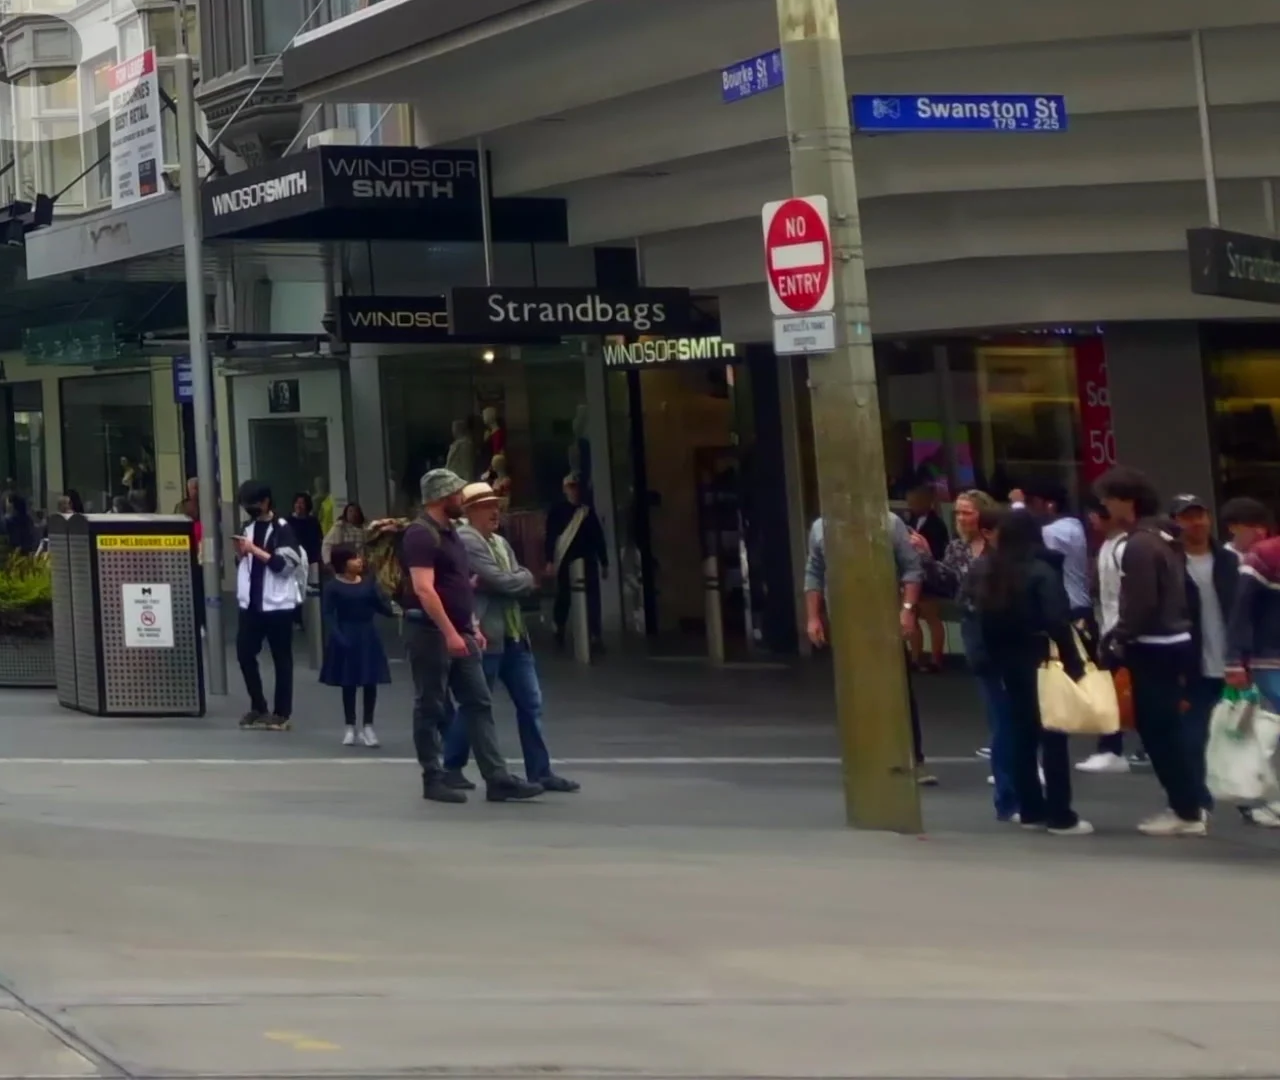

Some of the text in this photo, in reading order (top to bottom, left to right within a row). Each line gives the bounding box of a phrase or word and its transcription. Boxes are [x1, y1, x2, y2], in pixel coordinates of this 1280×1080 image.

[722, 64, 753, 90] Bourke
[917, 98, 1057, 118] Swanston St
[993, 119, 1016, 129] 179
[1034, 119, 1060, 129] 225
[328, 159, 476, 179] WINDSOR
[352, 179, 454, 199] SMITH
[785, 216, 806, 238] NO
[778, 272, 822, 297] ENTRY
[488, 294, 666, 330] Strandbags
[100, 537, 187, 547] KEEP MELBOURNE CLEAN
